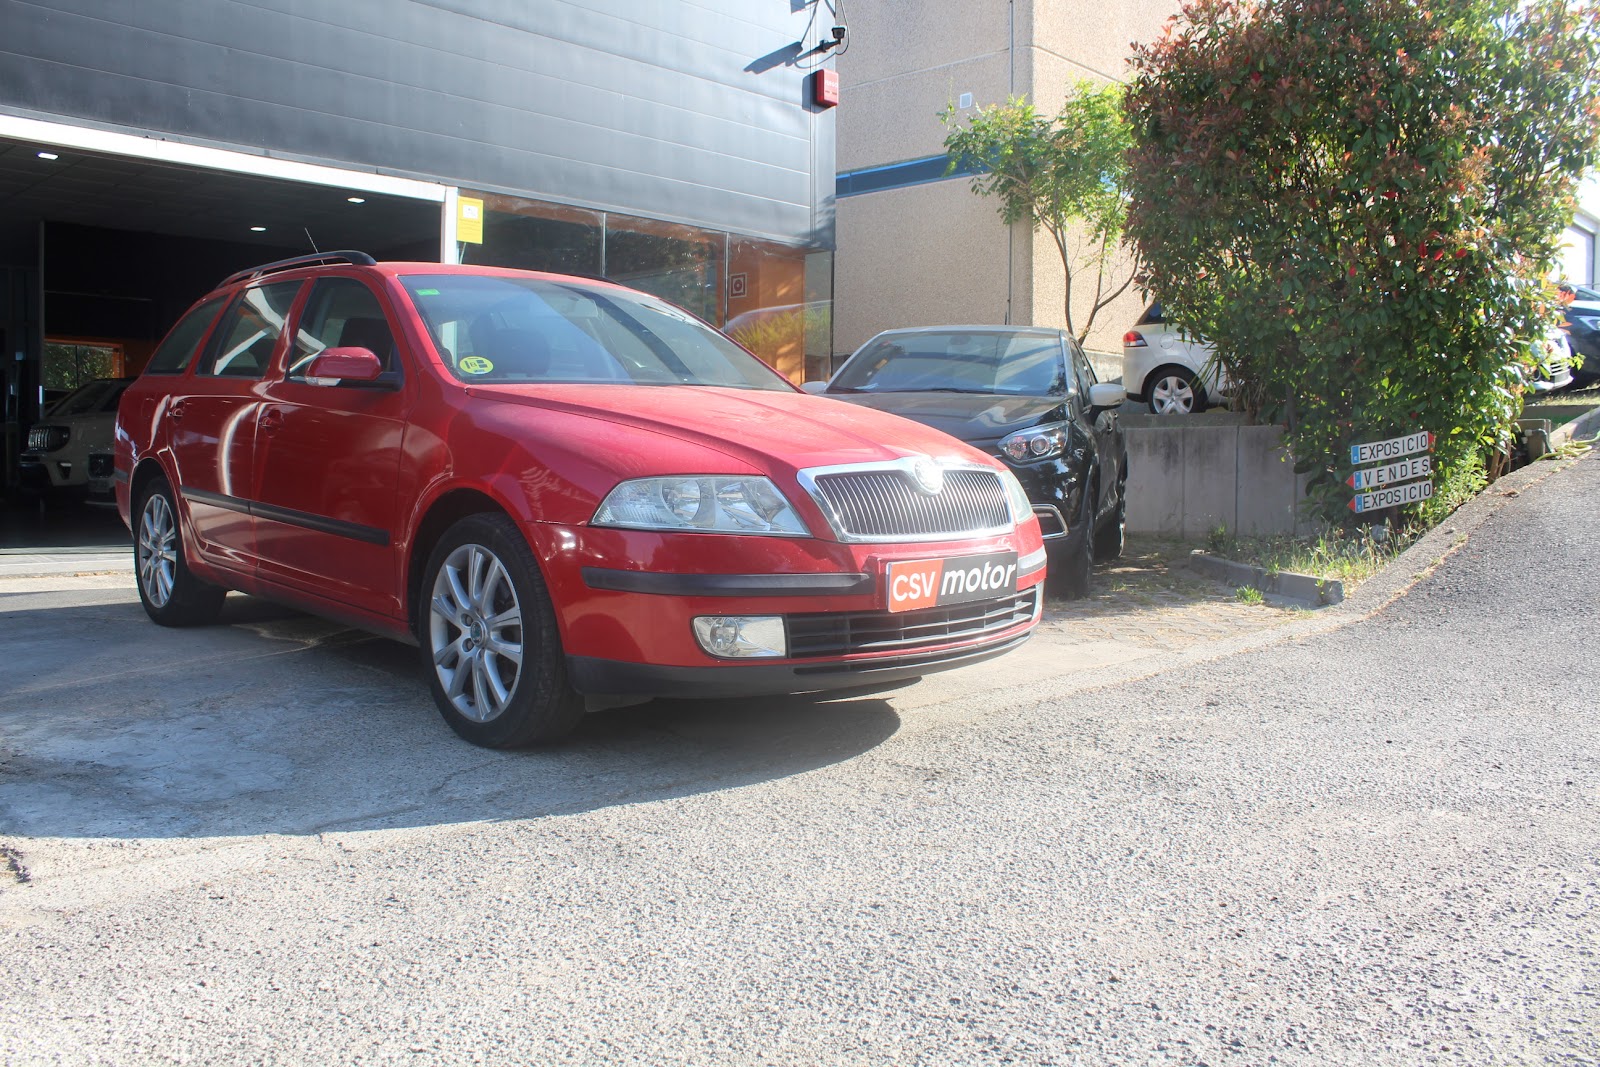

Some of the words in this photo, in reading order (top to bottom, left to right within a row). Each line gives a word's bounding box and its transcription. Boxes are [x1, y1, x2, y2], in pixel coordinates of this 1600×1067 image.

[1360, 434, 1427, 460] EXPOSICIO
[1364, 459, 1429, 485] VENDES
[1363, 483, 1431, 509] EXPOSICIO
[892, 571, 936, 602] CSV
[940, 561, 1016, 595] motor
